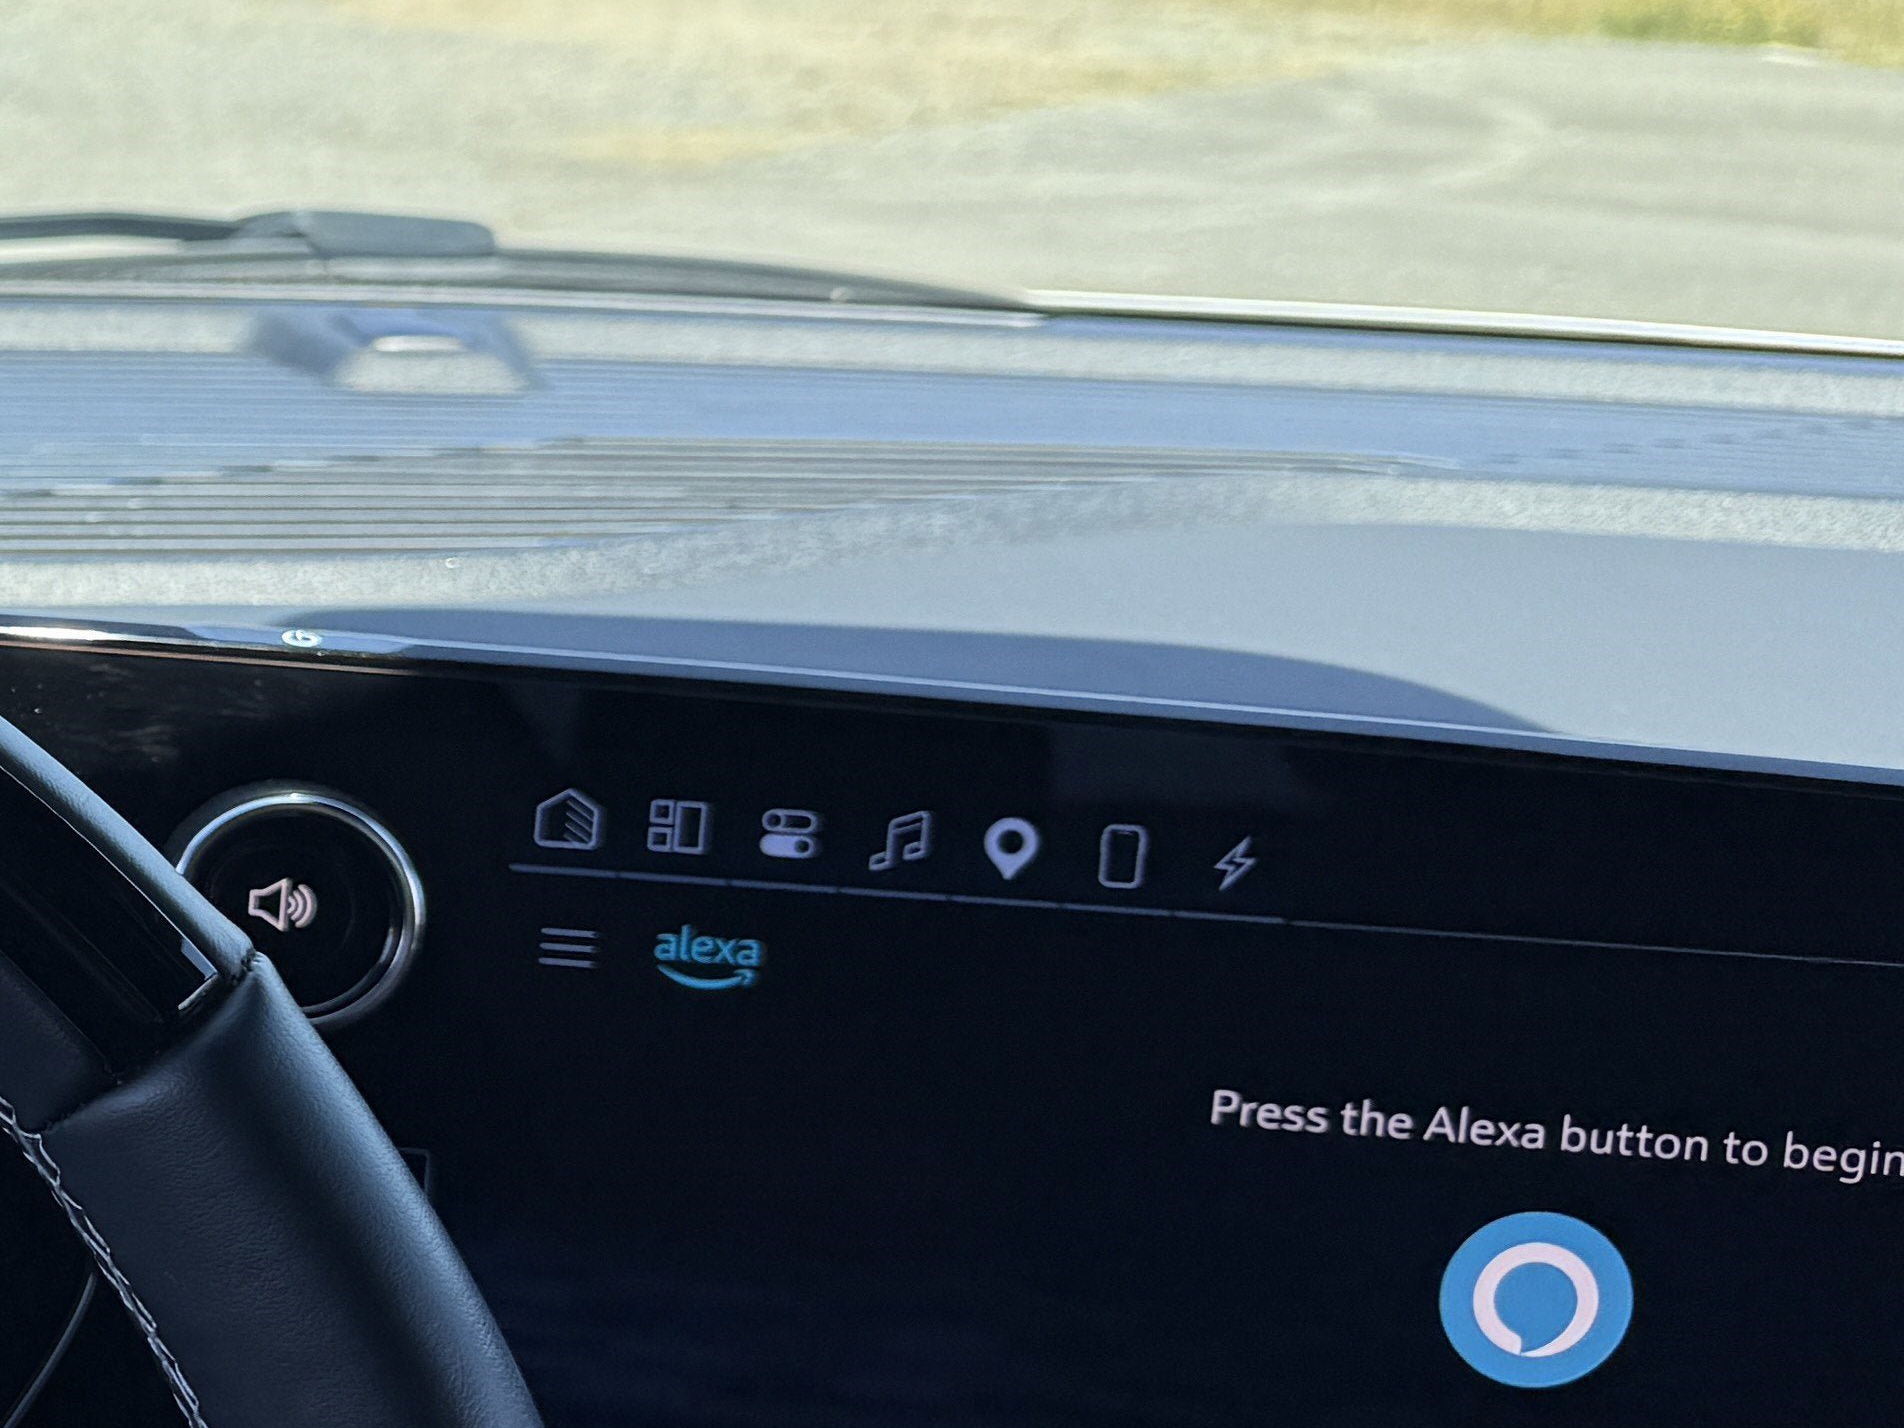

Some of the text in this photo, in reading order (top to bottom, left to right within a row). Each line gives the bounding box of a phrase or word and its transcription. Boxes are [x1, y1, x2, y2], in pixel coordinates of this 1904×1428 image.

[653, 924, 761, 967] alexa
[1210, 1089, 1330, 1135] Press
[1340, 1099, 1414, 1139] the
[1423, 1106, 1546, 1149] Alexa
[1561, 1115, 1709, 1164] button
[1723, 1130, 1768, 1167] to
